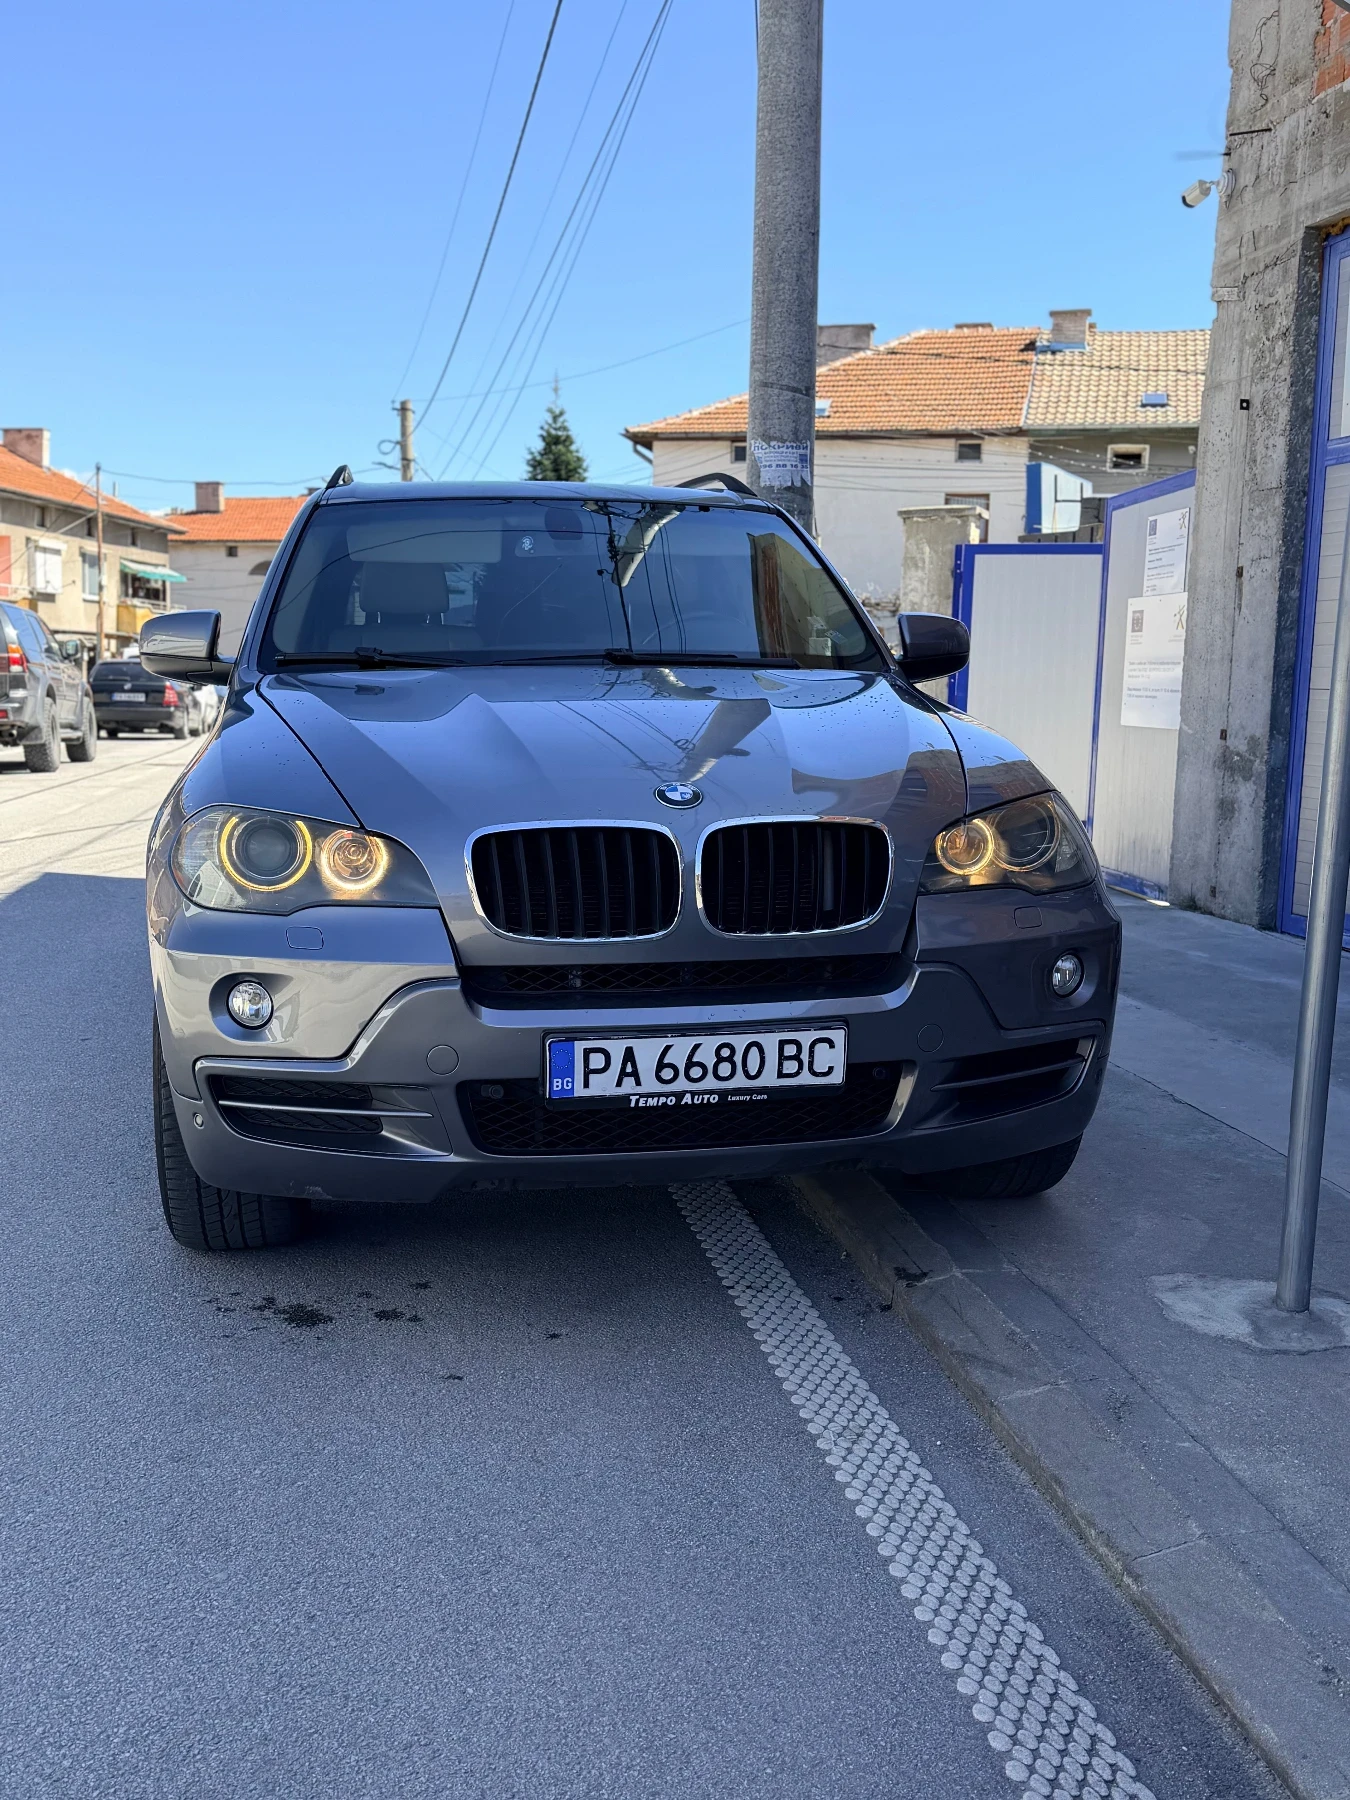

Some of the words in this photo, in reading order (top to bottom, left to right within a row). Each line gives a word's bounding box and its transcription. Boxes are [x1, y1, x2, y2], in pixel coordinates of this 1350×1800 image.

[654, 1040, 766, 1085] 6680
[553, 1077, 573, 1091] BG
[629, 1095, 676, 1107] TEMPO
[681, 1093, 719, 1105] AUTO
